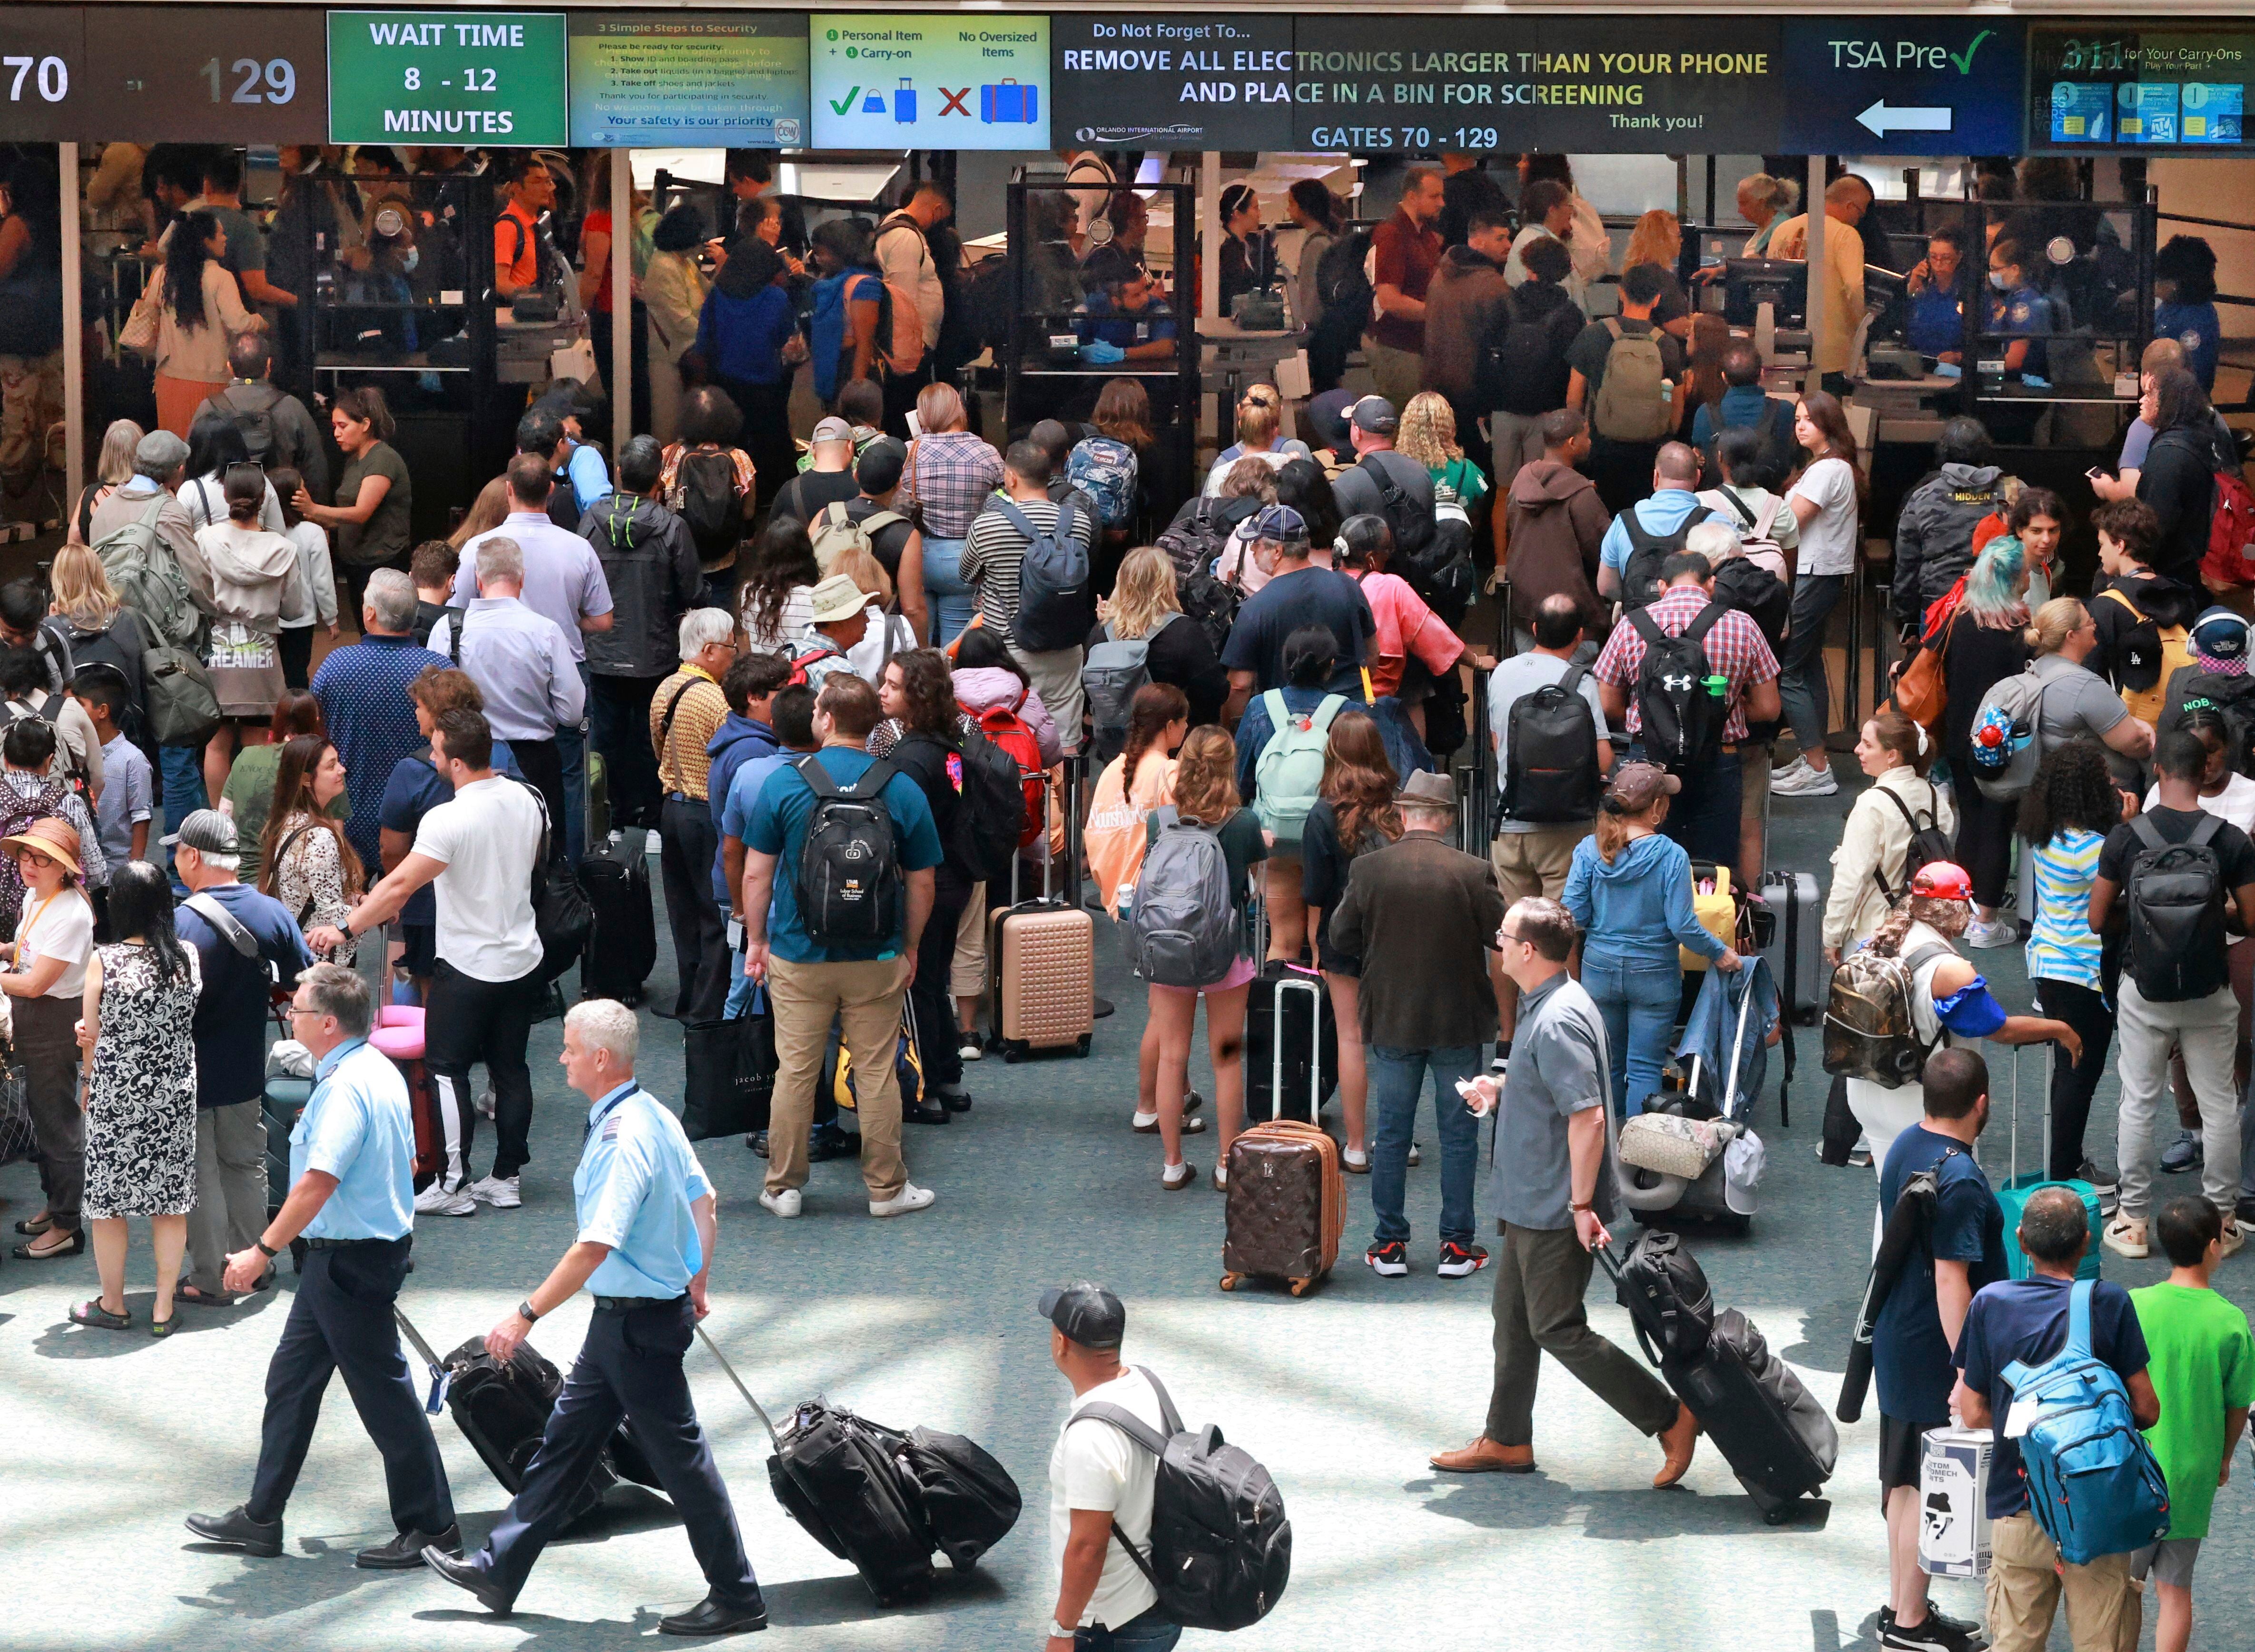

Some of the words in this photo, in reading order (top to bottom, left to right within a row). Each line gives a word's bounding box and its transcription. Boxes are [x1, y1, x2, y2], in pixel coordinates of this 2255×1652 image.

[369, 23, 446, 46] WAIT
[453, 24, 524, 47] TIME
[599, 24, 605, 32] 3
[610, 23, 651, 33] Simple
[654, 24, 688, 33] Steps
[707, 24, 758, 34] Security
[842, 30, 892, 40] Personal
[896, 30, 922, 41] Item
[1093, 23, 1116, 38] Do
[1121, 24, 1152, 38] Not
[1157, 24, 1211, 41] Forget
[1215, 25, 1251, 39] To...
[959, 31, 975, 41] No
[979, 31, 1038, 42] Oversized
[861, 48, 912, 60] Carry-on
[982, 47, 1014, 58] Items
[1828, 41, 1887, 69] TSA
[1897, 41, 1947, 69] Pre
[2125, 48, 2142, 59] for
[2147, 48, 2175, 60] Your
[2179, 48, 2242, 62] Carry-Ons
[1064, 49, 1172, 71] REMOVE
[1179, 50, 1225, 71] ALL
[1233, 50, 1402, 73] ELECTRONICS
[1411, 52, 1509, 73] LARGER
[1516, 52, 1590, 74] THAN
[1603, 53, 1672, 75] YOUR
[1680, 53, 1768, 75] PHONE
[2145, 61, 2161, 71] Play
[2165, 62, 2182, 70] Your
[2185, 62, 2202, 70] Part
[3, 56, 68, 101] 70
[199, 58, 296, 104] 129
[404, 67, 421, 90] 8
[463, 69, 497, 91] 12
[1179, 82, 1237, 103] AND
[1245, 82, 1324, 104] PLACE
[1332, 83, 1358, 103] IN
[1366, 84, 1385, 103] A
[1394, 84, 1435, 104] BIN
[1443, 84, 1493, 105] FOR
[1500, 84, 1644, 106] SCREENING
[665, 104, 687, 112] may
[740, 104, 782, 113] through
[384, 110, 513, 133] MINUTES
[608, 116, 637, 125] Your
[641, 116, 680, 126] safety
[685, 117, 694, 125] is
[724, 117, 773, 127] priority
[1609, 114, 1661, 129] Thank
[1665, 114, 1704, 130] you!
[1311, 127, 1393, 148] GATES
[1401, 127, 1430, 148] 70
[1455, 127, 1498, 148] 129
[1955, 492, 1990, 501] HIDDEN
[209, 648, 274, 668] REAMER
[2130, 652, 2141, 665] LA
[735, 1073, 761, 1086] jacob
